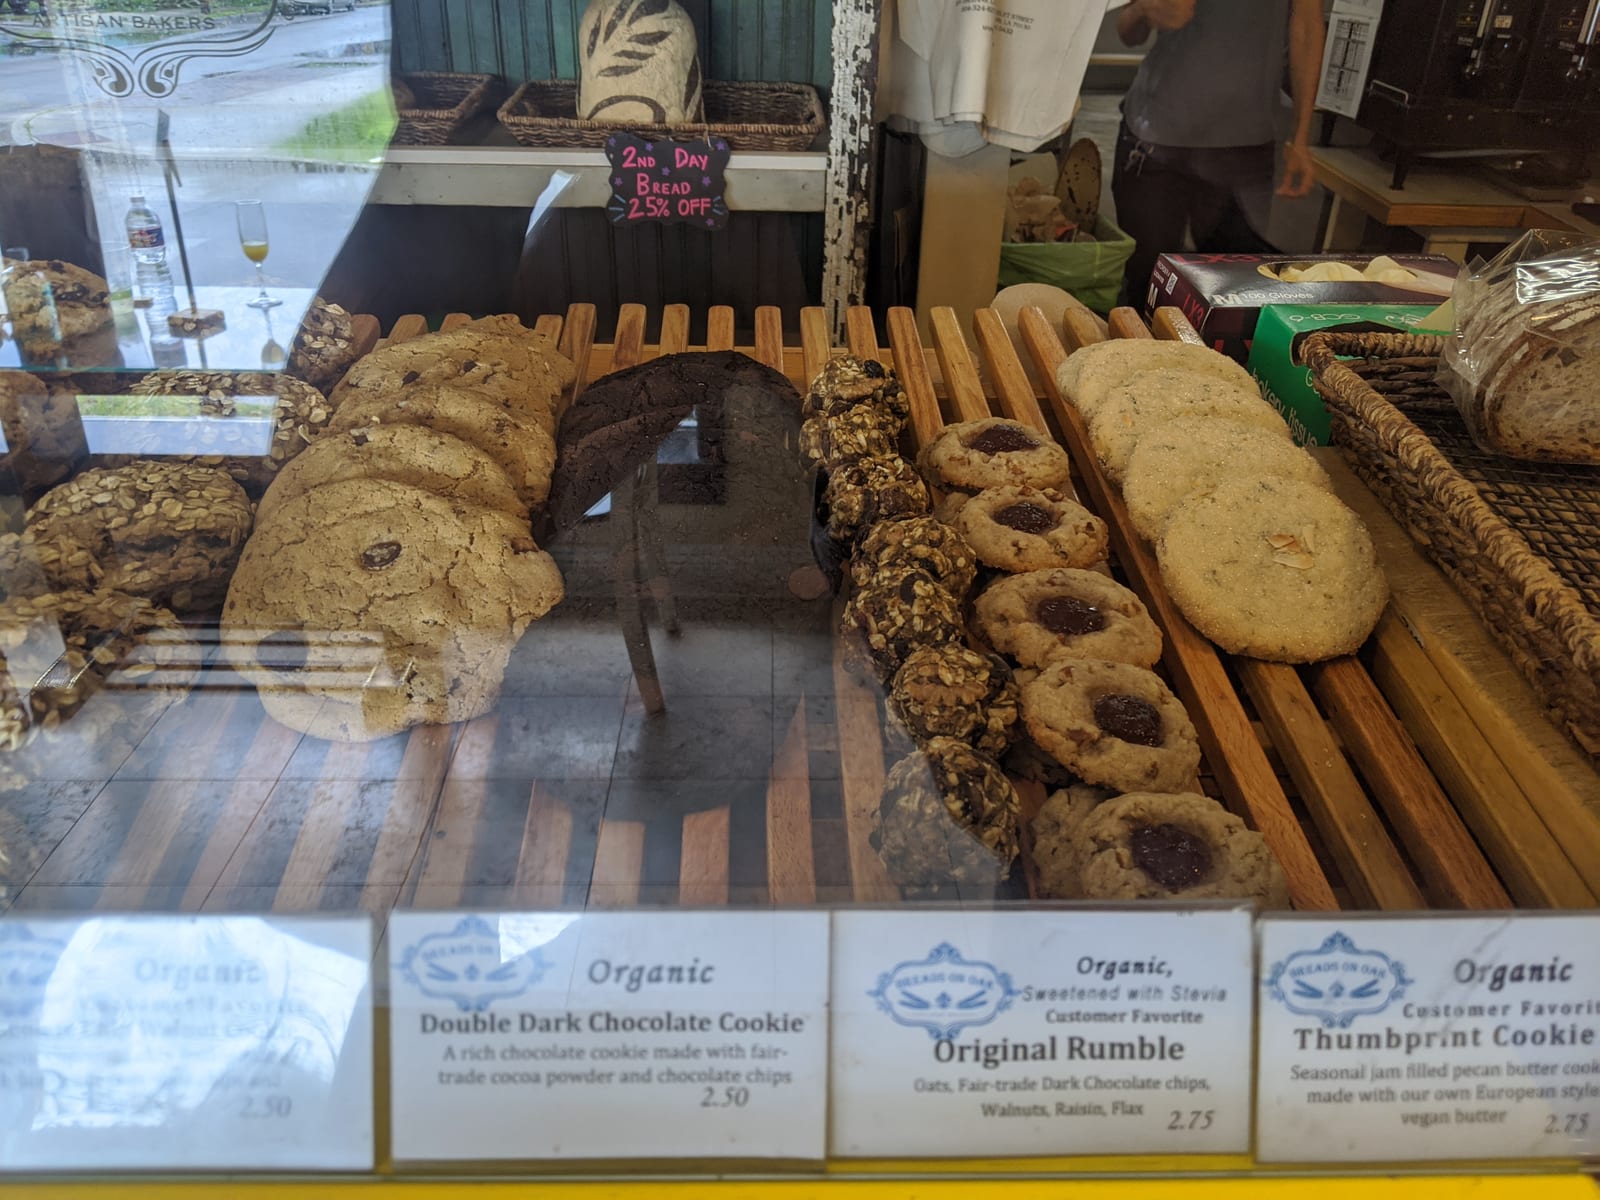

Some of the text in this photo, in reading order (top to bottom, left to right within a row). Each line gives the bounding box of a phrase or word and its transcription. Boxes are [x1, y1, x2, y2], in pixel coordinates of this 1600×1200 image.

[33, 15, 216, 31] ARTISAN BAKERS
[621, 145, 708, 171] 2ND DAY
[636, 172, 691, 196] BREAD
[627, 196, 712, 219] 25% OFF
[1269, 292, 1314, 300] Gloves
[588, 957, 715, 992] Organic
[1077, 956, 1173, 980] Organic,
[1454, 957, 1573, 992] Organic
[1023, 984, 1227, 1002] Sweetened with Stevia
[1045, 1008, 1204, 1024] Customer Favorite
[1402, 1000, 1600, 1019] Customer Favorit
[420, 1011, 804, 1035] Double Dark Chocolate Cookie
[1294, 1023, 1595, 1054] Thumbprint Cookie
[443, 1043, 788, 1061] A rich chocolate cookie made with fair-
[934, 1035, 1184, 1069] Original Rumble
[438, 1066, 792, 1089] trade cocoa powder and chocolate chips
[1290, 1060, 1600, 1083] Seasonal jam filled pecan butter cook
[914, 1074, 1211, 1094] Oats, Fair-trade Dark Chocolate chips,
[1307, 1082, 1600, 1103] made with our own European style
[239, 1094, 292, 1119] 2.50
[700, 1086, 749, 1107] 2.50
[981, 1101, 1143, 1118] Walnuts, Raisin, Flax
[1167, 1109, 1215, 1131] 2.75
[1400, 1109, 1506, 1127] vegan butter
[1545, 1113, 1590, 1135] 2.75
